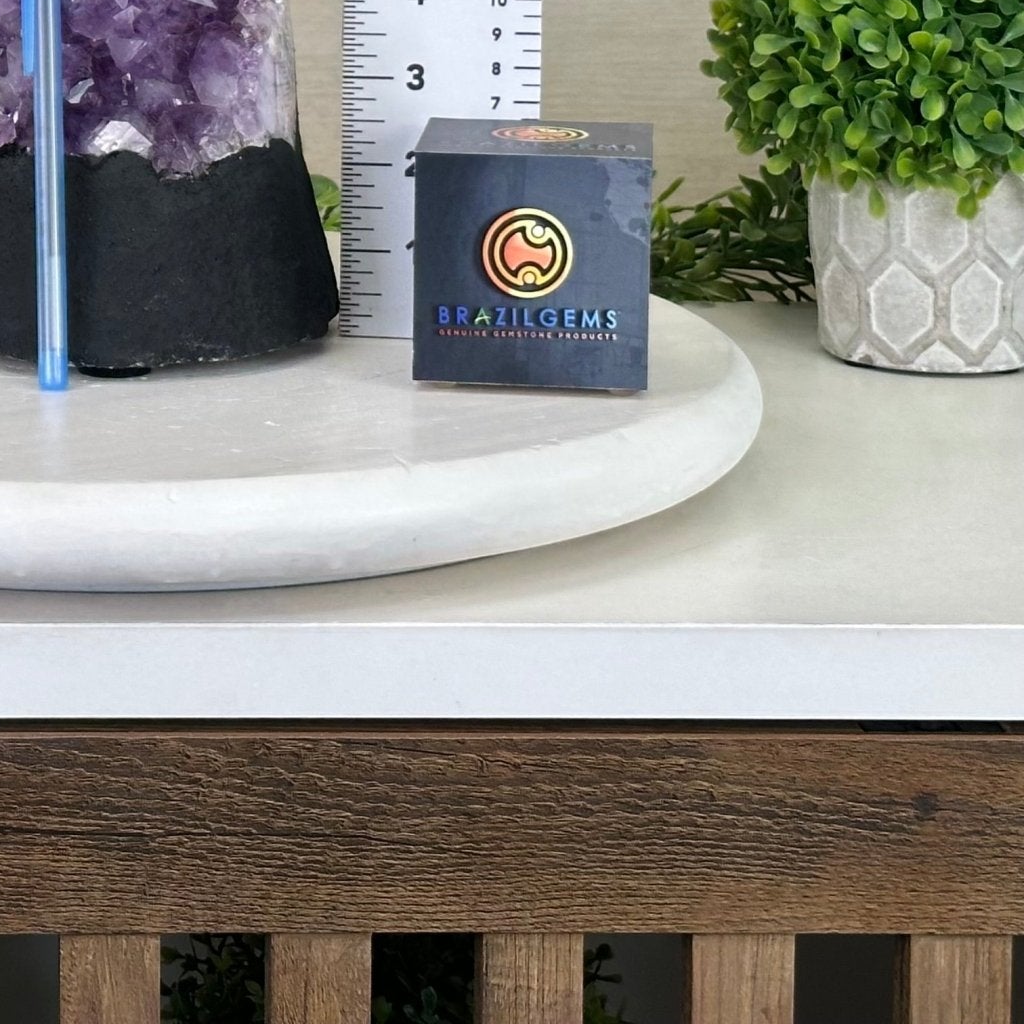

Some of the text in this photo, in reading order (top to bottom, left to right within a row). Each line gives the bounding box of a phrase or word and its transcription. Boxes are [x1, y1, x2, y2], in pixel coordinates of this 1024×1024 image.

[491, 27, 502, 42] 9
[491, 61, 501, 76] 8
[406, 63, 425, 91] 3
[490, 96, 501, 110] 7
[437, 305, 618, 330] BRAZILGEMS
[438, 329, 617, 340] GENUINE GEMSTONE PRODUCTS
